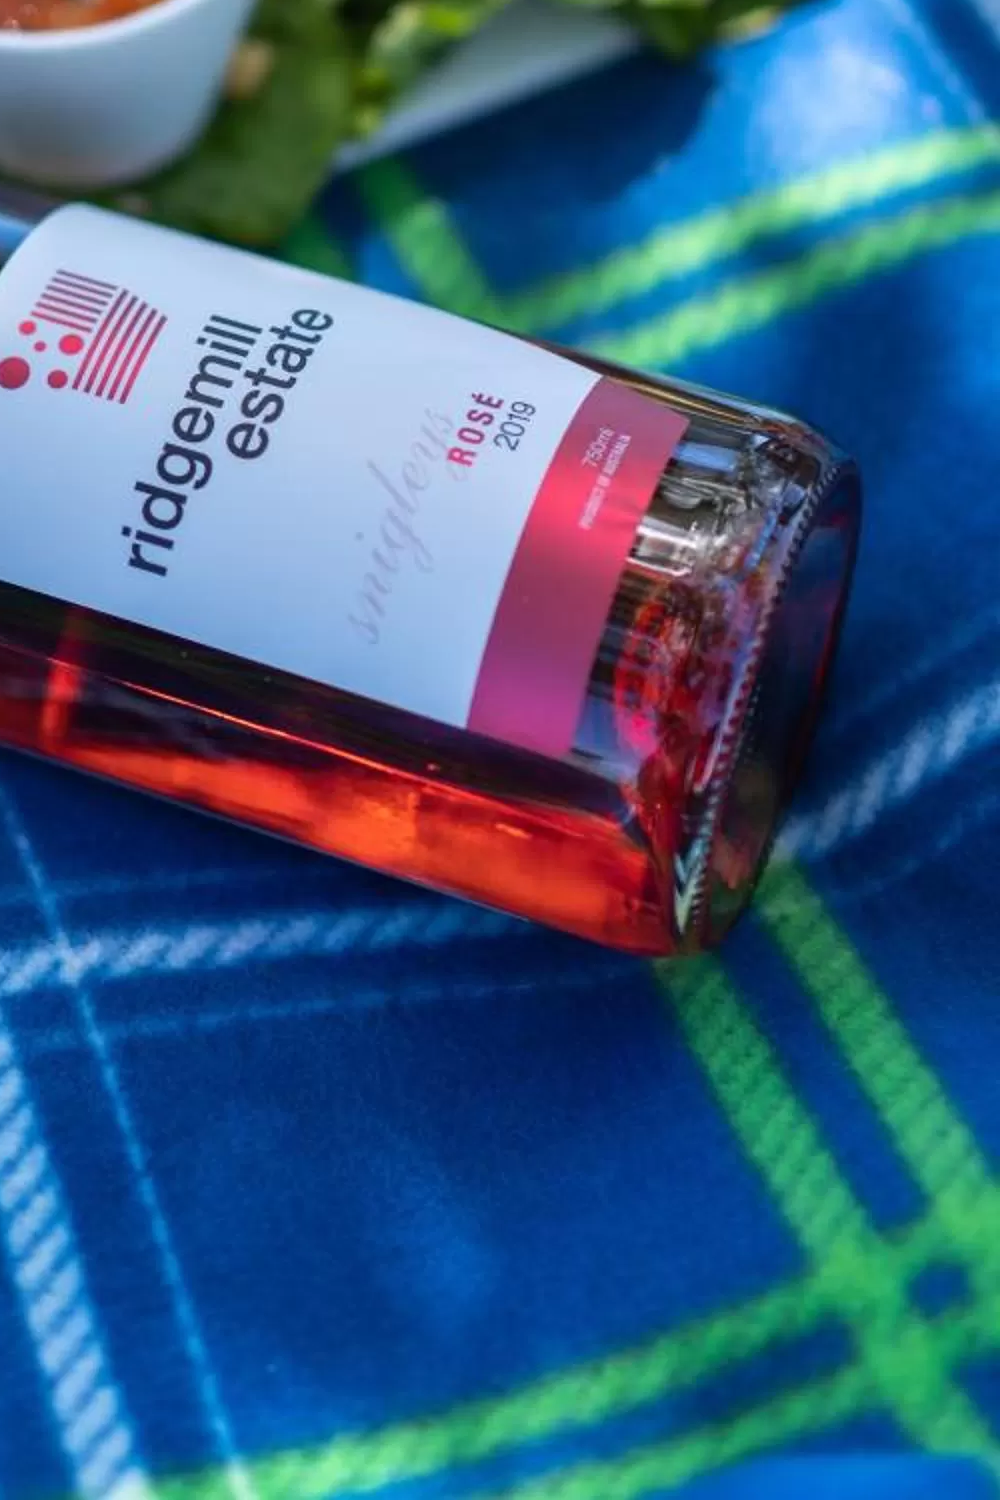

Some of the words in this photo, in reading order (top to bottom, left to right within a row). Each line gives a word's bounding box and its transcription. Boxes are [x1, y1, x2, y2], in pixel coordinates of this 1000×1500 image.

[226, 309, 334, 460] estate
[446, 392, 505, 467] ROSÉ
[493, 401, 537, 452] 2019
[121, 315, 263, 577] ridgemill
